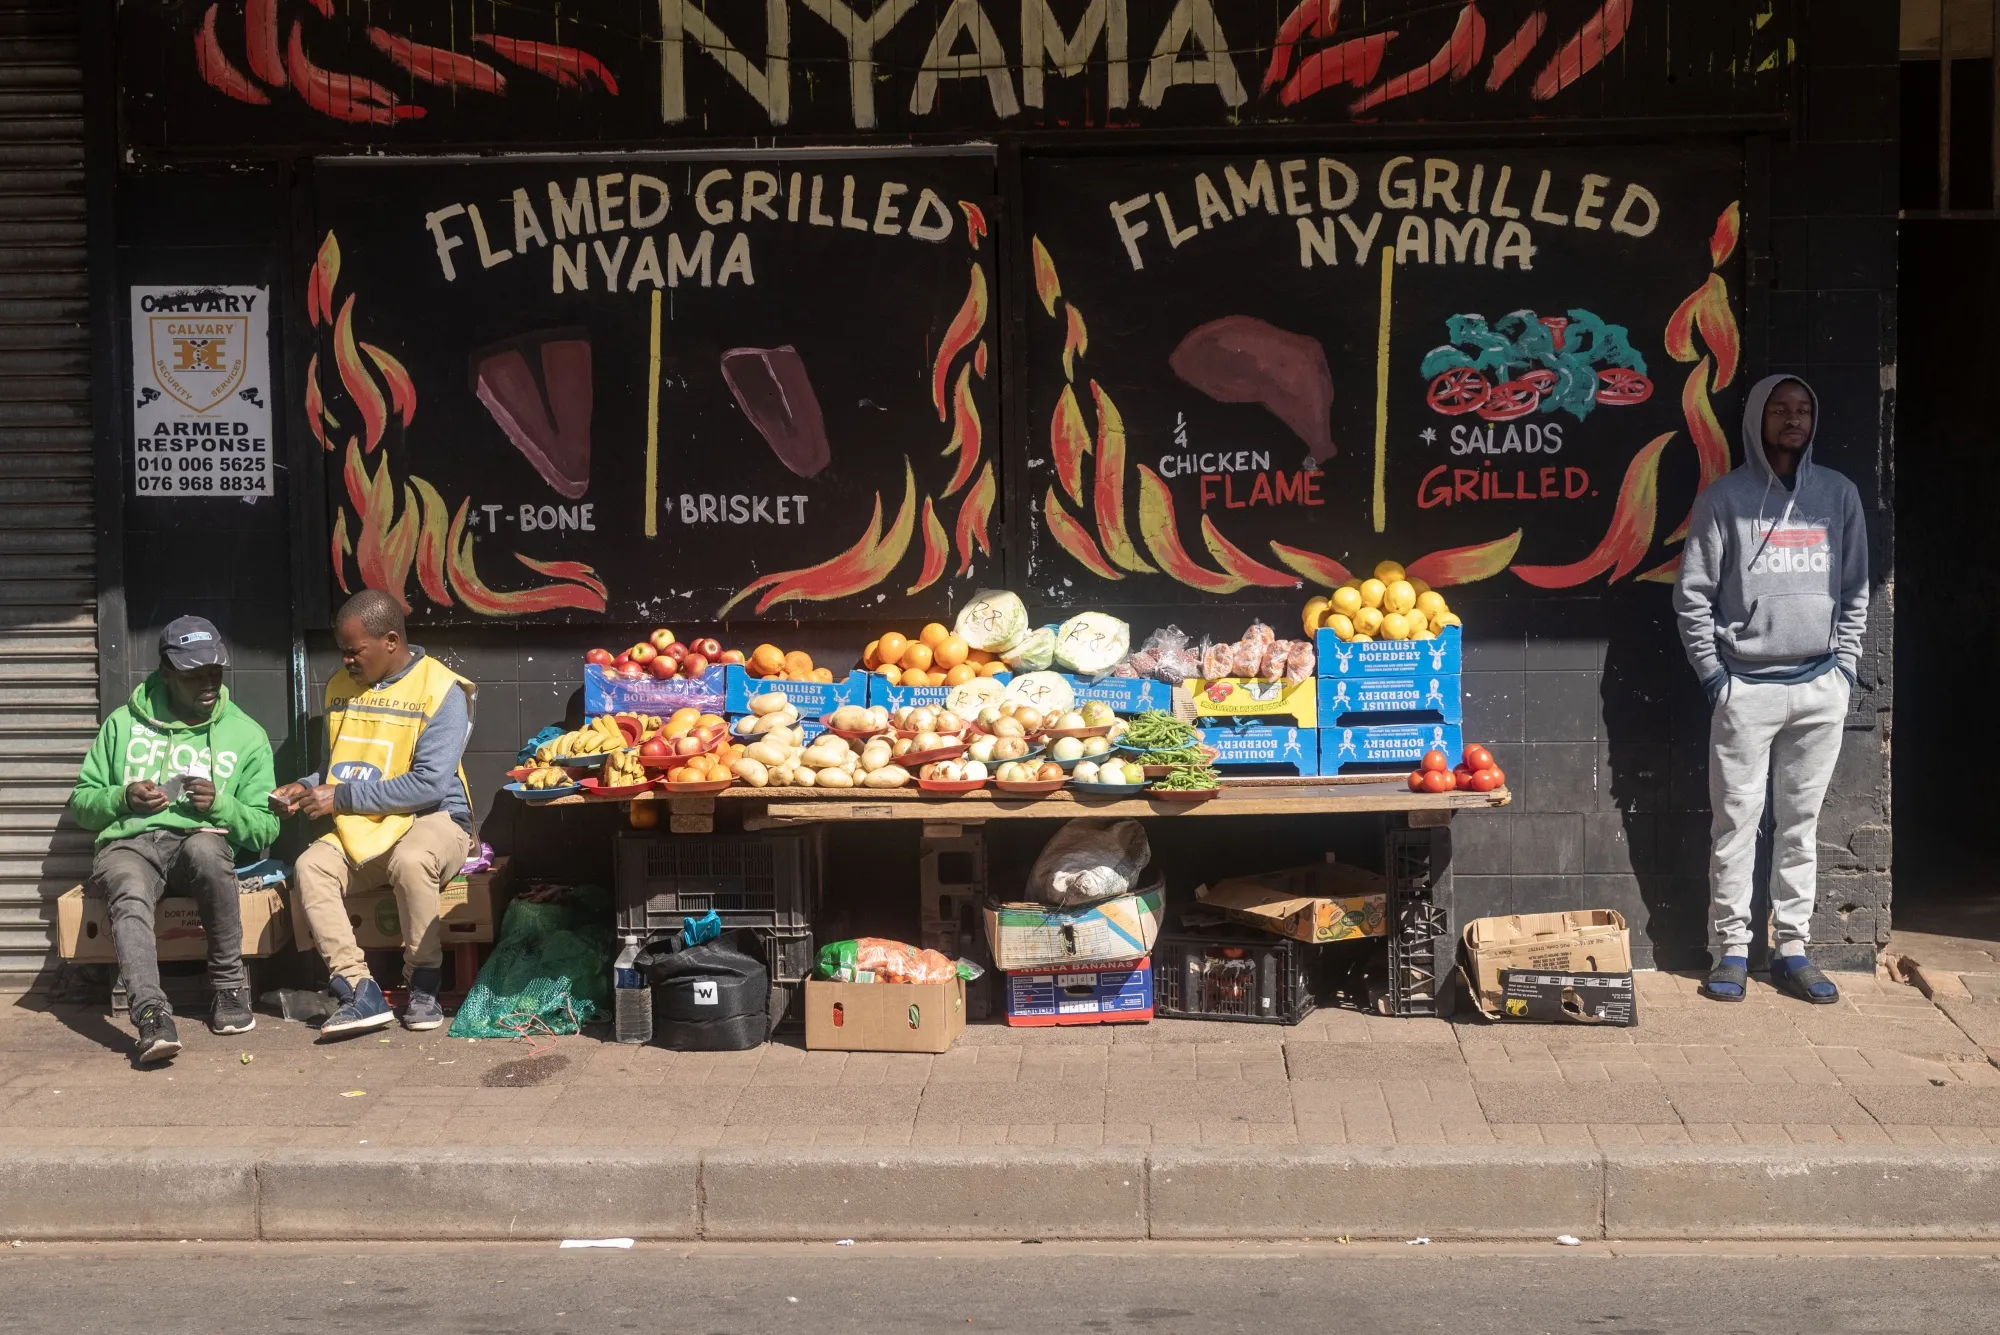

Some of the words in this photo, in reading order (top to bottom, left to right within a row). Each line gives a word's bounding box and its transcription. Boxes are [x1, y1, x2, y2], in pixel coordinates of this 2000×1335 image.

[660, 0, 1249, 129] NYAMA
[1109, 157, 1360, 271] FLAMED
[1378, 155, 1661, 238] GRILLED
[425, 171, 673, 282] FLAMED
[694, 168, 955, 242] GRILLED
[1296, 211, 1538, 271] NYAMA
[552, 232, 755, 294] NYAMA
[167, 323, 234, 335] CALVARY
[156, 359, 193, 401] SECURITY
[211, 358, 242, 398] SERVICES
[153, 422, 249, 436] ARMED
[137, 438, 266, 452] RESPONSE
[1449, 423, 1563, 455] SALADS
[137, 457, 173, 472] 010
[178, 457, 214, 472] 006
[219, 457, 266, 472] 5625
[1159, 451, 1271, 478] CHICKEN
[137, 476, 173, 491] 076
[178, 476, 214, 491] 968
[219, 476, 267, 491] 8834
[1200, 469, 1325, 510] FLAME
[679, 493, 809, 525] BRISKET
[481, 503, 596, 533] T-BONE
[1749, 544, 1836, 574] adidas
[1362, 641, 1417, 652] BOULUST
[1358, 651, 1421, 662] BOERDERY
[770, 683, 823, 695] BOULUST
[1357, 690, 1420, 701] BOERDERY
[370, 697, 400, 708] HELP
[402, 701, 427, 712] YOU?
[1361, 700, 1417, 711] BOULUST
[1216, 739, 1278, 749] BOERDERY
[1363, 738, 1425, 749] BOERDERY
[1220, 749, 1275, 759] BOULUST
[1367, 748, 1421, 759] BOULUST
[339, 765, 374, 781] MTN
[1072, 960, 1135, 971] BANANAS
[698, 987, 713, 999] W
